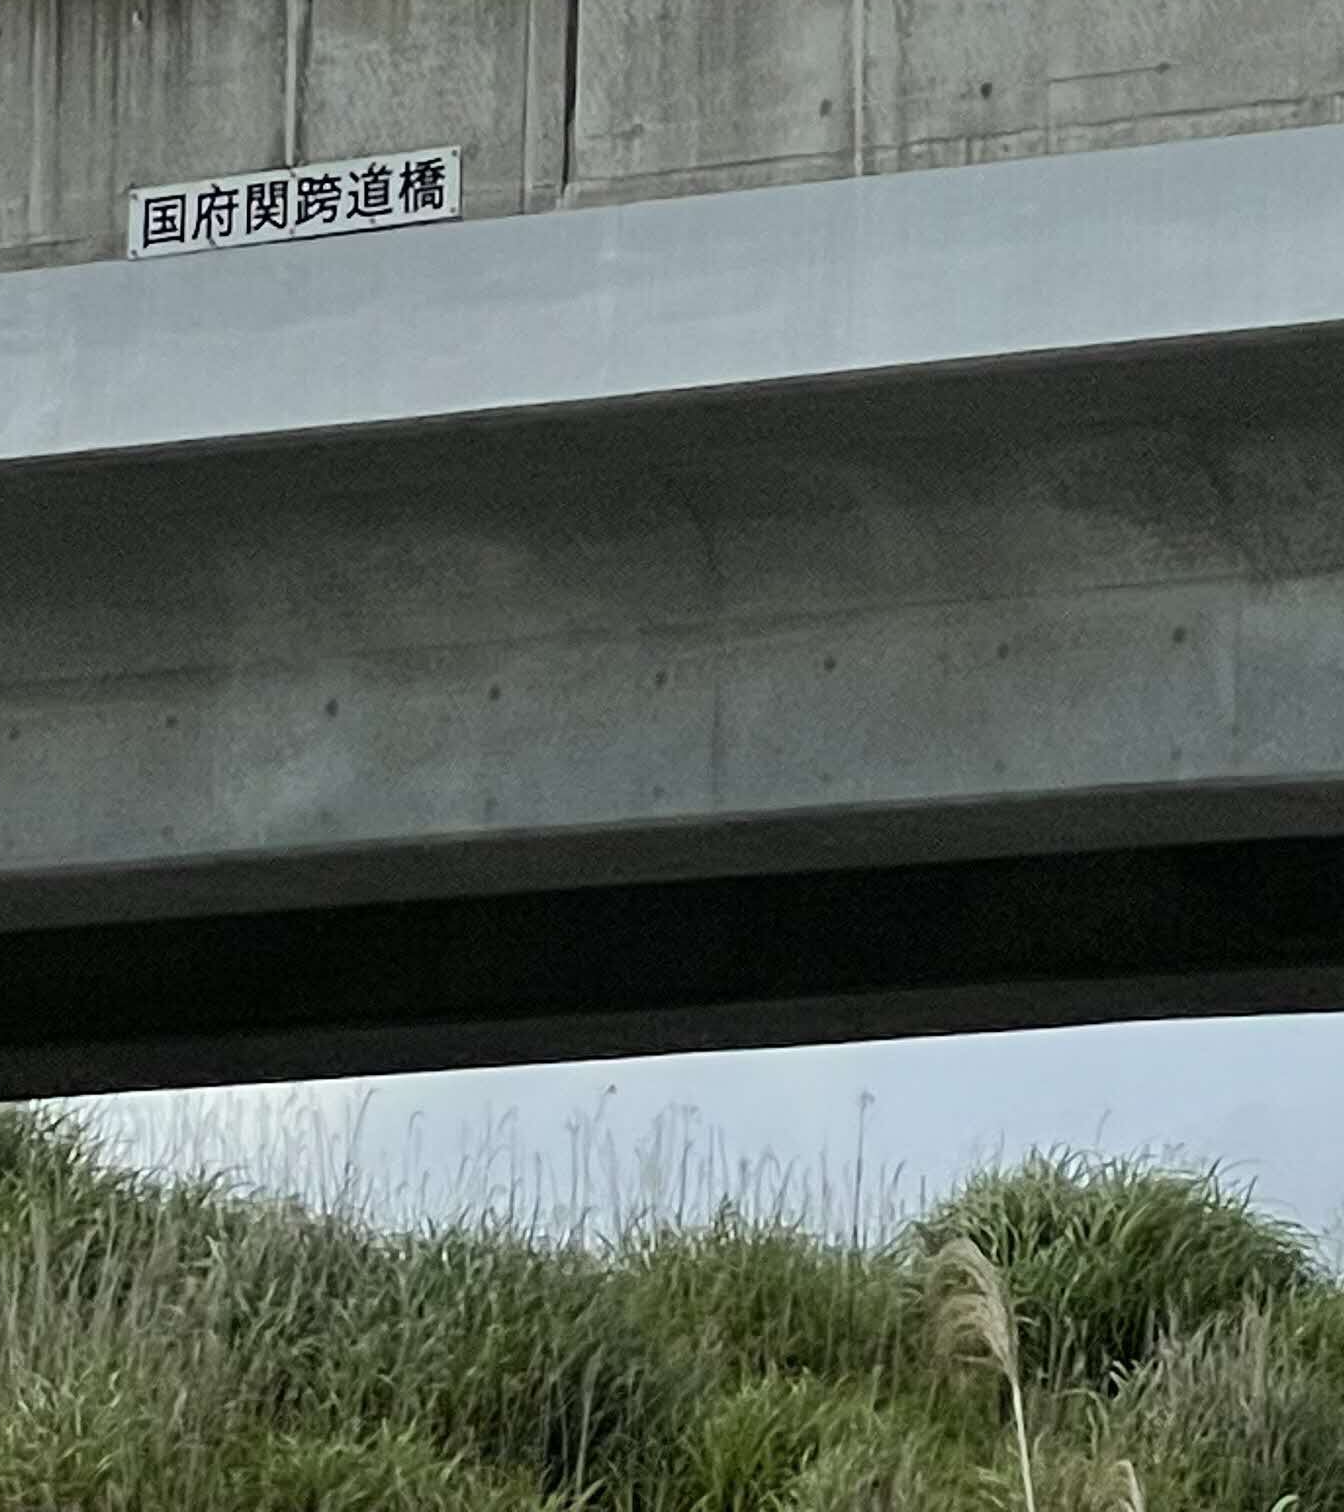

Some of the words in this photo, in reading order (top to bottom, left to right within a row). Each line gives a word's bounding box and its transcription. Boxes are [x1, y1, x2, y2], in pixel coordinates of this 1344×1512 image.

[142, 157, 445, 248] 国府関跨道橋
